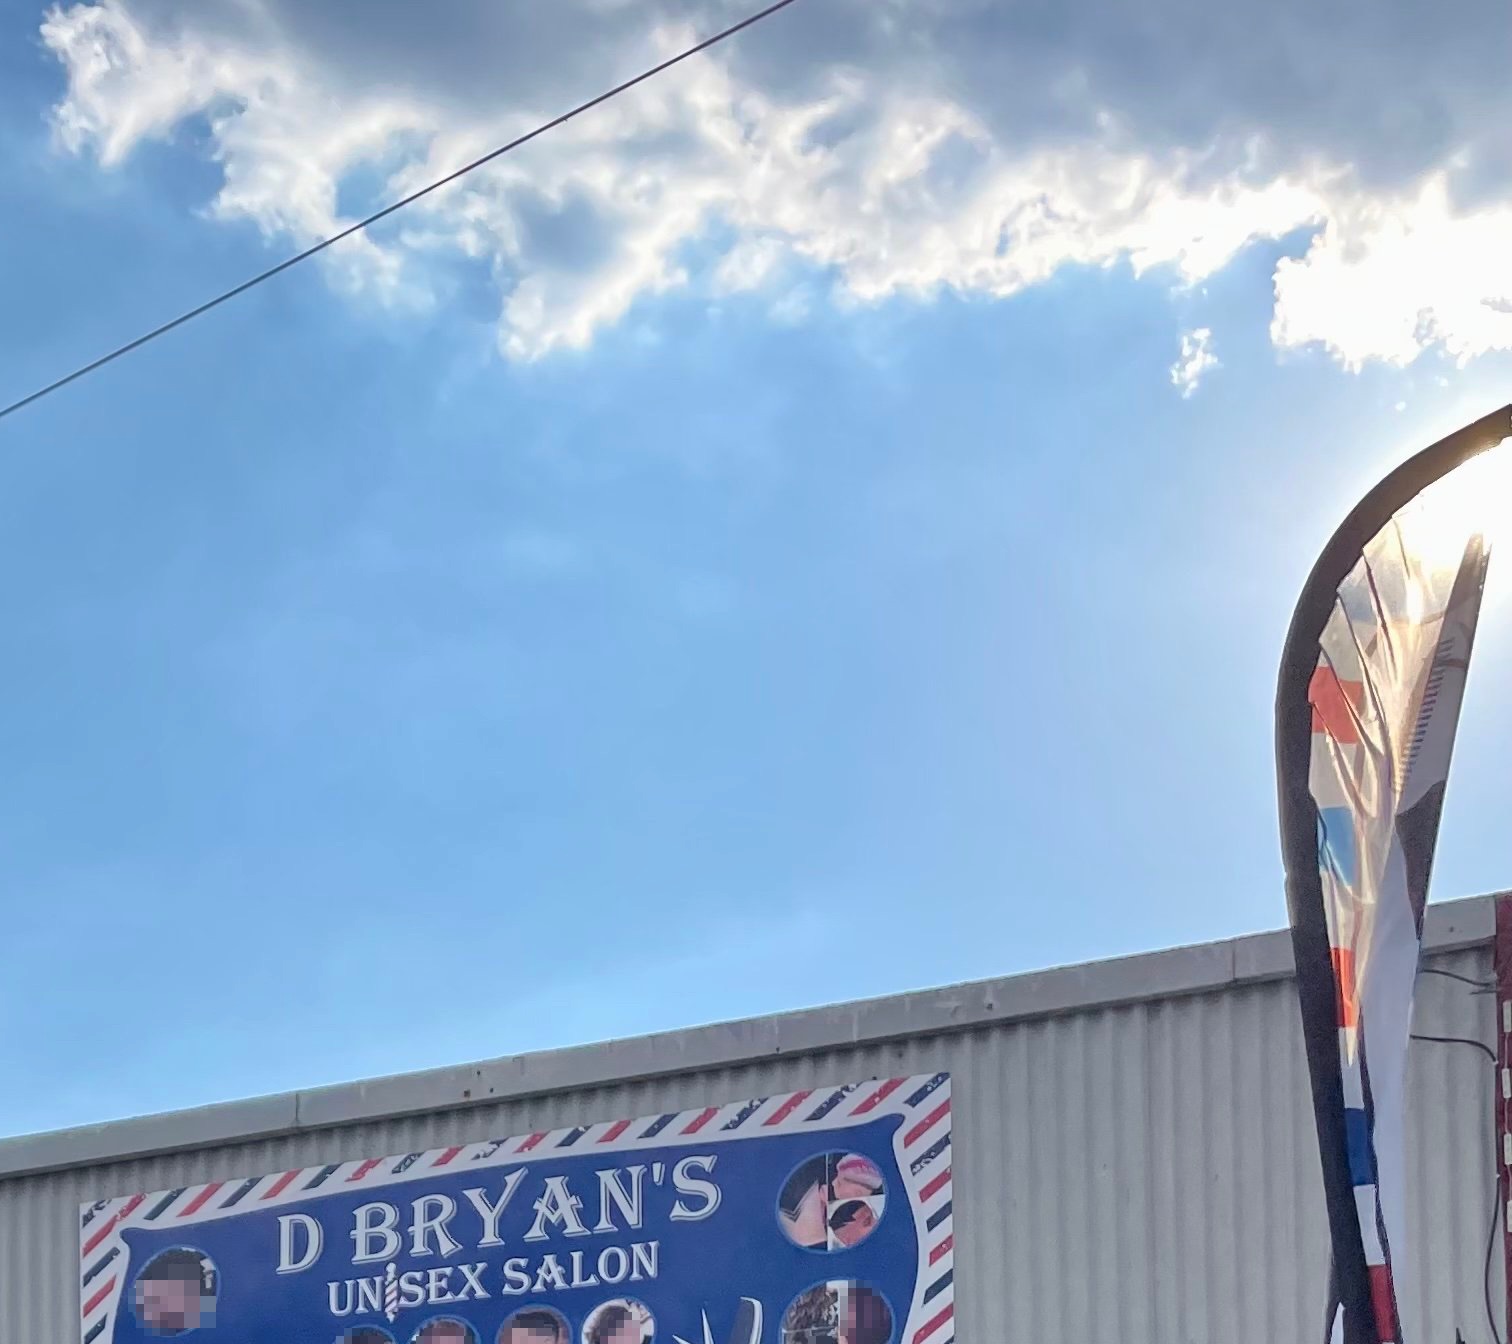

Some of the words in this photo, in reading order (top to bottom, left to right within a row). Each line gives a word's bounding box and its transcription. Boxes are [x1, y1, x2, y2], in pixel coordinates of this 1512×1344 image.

[275, 1212, 324, 1275] D
[350, 1154, 723, 1268] BRYAN'S
[328, 1261, 490, 1322] UNISEX
[501, 1241, 661, 1295] SALON
